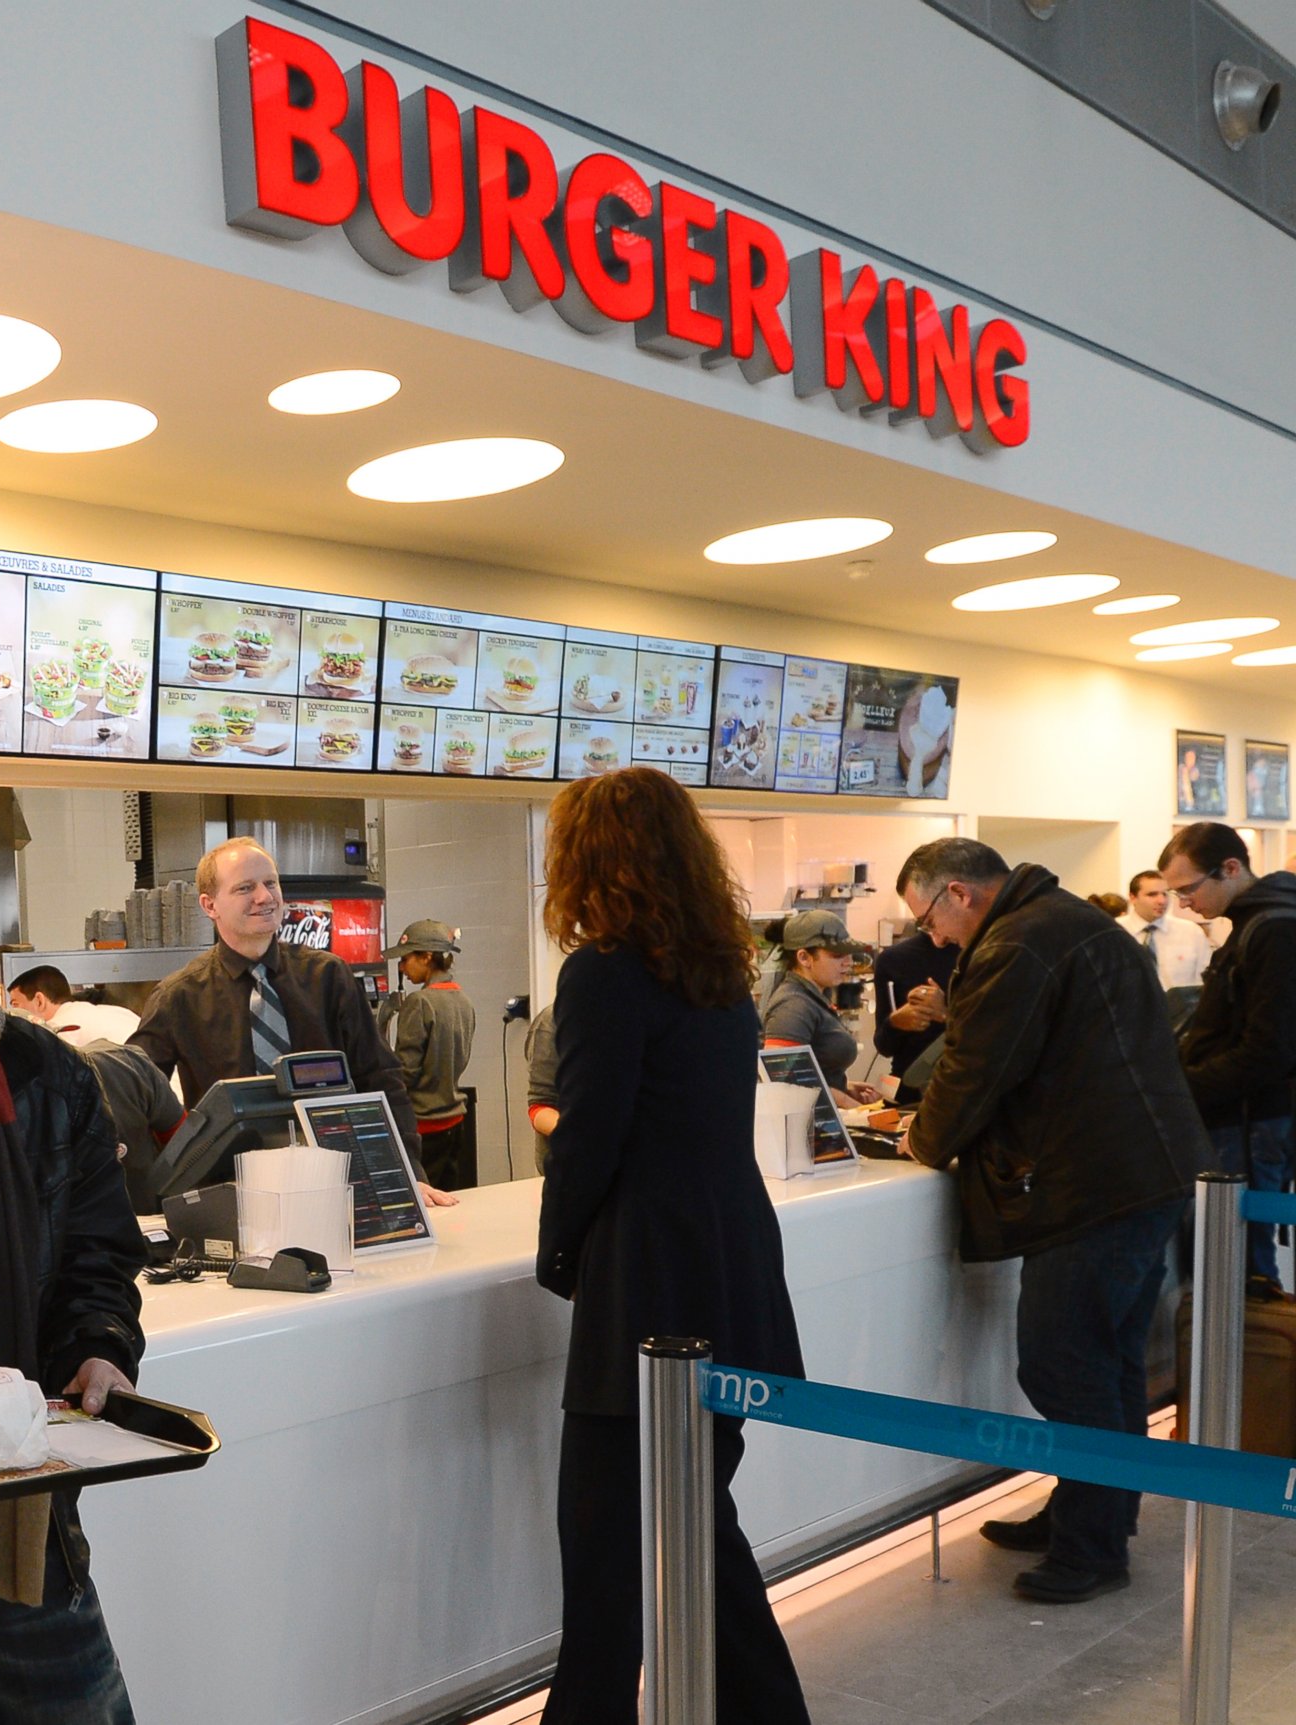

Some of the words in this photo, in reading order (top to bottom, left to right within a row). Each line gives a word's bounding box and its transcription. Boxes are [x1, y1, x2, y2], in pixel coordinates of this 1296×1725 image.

[245, 15, 795, 376] BURGER
[818, 247, 1031, 448] KING
[41, 561, 50, 573] &
[50, 562, 93, 578] SALADES
[33, 581, 66, 593] SALADES
[702, 1370, 770, 1413] mp
